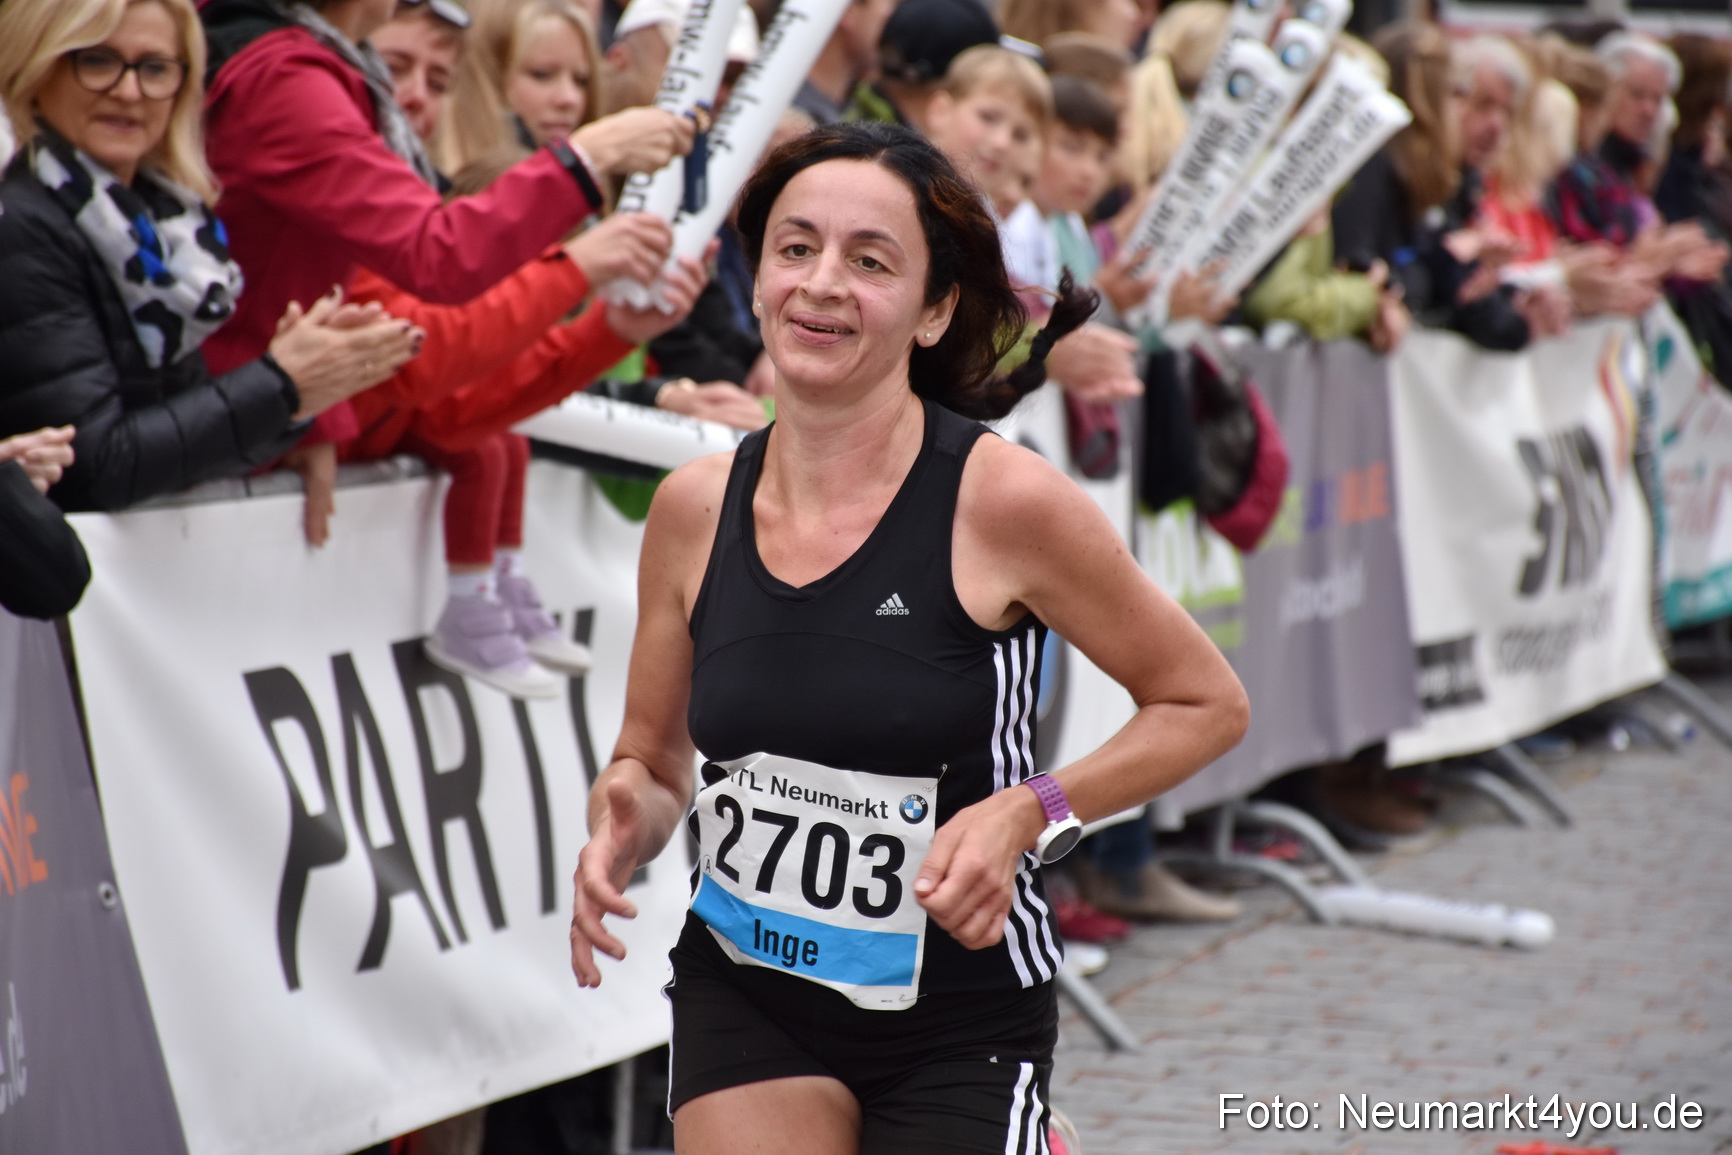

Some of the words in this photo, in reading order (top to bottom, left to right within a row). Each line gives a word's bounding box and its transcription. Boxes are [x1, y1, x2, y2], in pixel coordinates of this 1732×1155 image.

[876, 607, 910, 616] adidas
[730, 767, 763, 793] TL
[770, 775, 888, 819] Neumarkt
[714, 793, 906, 919] 2703
[754, 918, 819, 968] Inge
